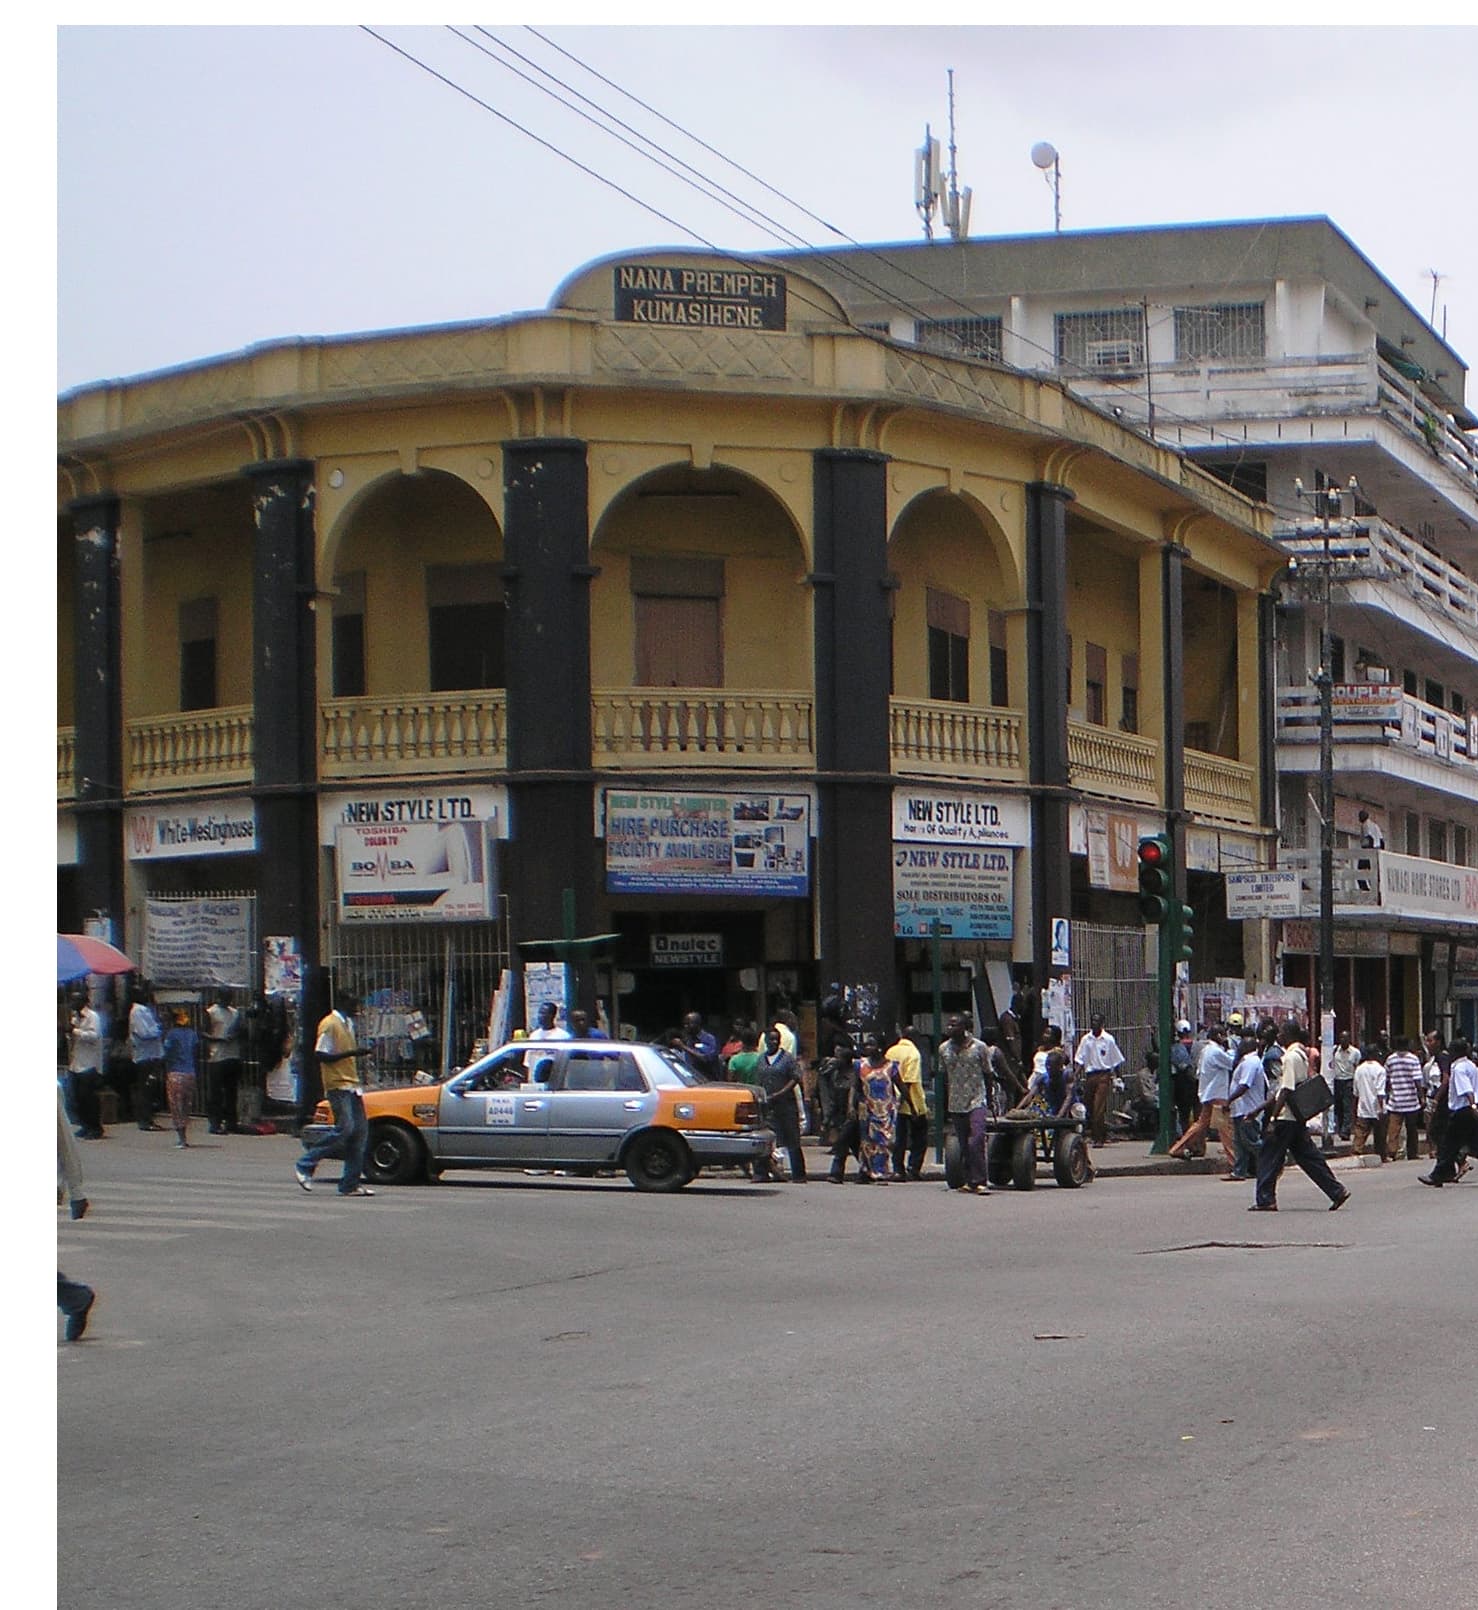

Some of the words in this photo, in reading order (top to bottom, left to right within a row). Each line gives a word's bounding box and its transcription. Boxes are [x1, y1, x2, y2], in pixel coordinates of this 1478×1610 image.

[620, 267, 673, 291] NANA
[682, 271, 777, 297] PREMPEH
[633, 299, 763, 327] KUMASIHENE
[1331, 683, 1401, 698] OUPLES
[347, 801, 379, 823] NEW
[381, 799, 433, 821] STYLE
[438, 798, 476, 819] LTD.
[908, 799, 933, 821] NEW
[936, 801, 972, 825] STYLE
[975, 804, 1001, 826] LTD.
[157, 815, 255, 846] White-Westinghouse
[356, 826, 408, 835] TOSHIBA
[611, 817, 649, 837] HIRE
[650, 818, 729, 838] PURCHASE
[608, 840, 661, 858] FACILITY
[664, 841, 732, 861] AVAILABLE
[909, 850, 940, 868] NEW
[942, 852, 980, 870] STYLE
[897, 890, 920, 900] SOLE
[922, 890, 990, 903] DISTRIBUTORS
[1429, 874, 1450, 900] STORES
